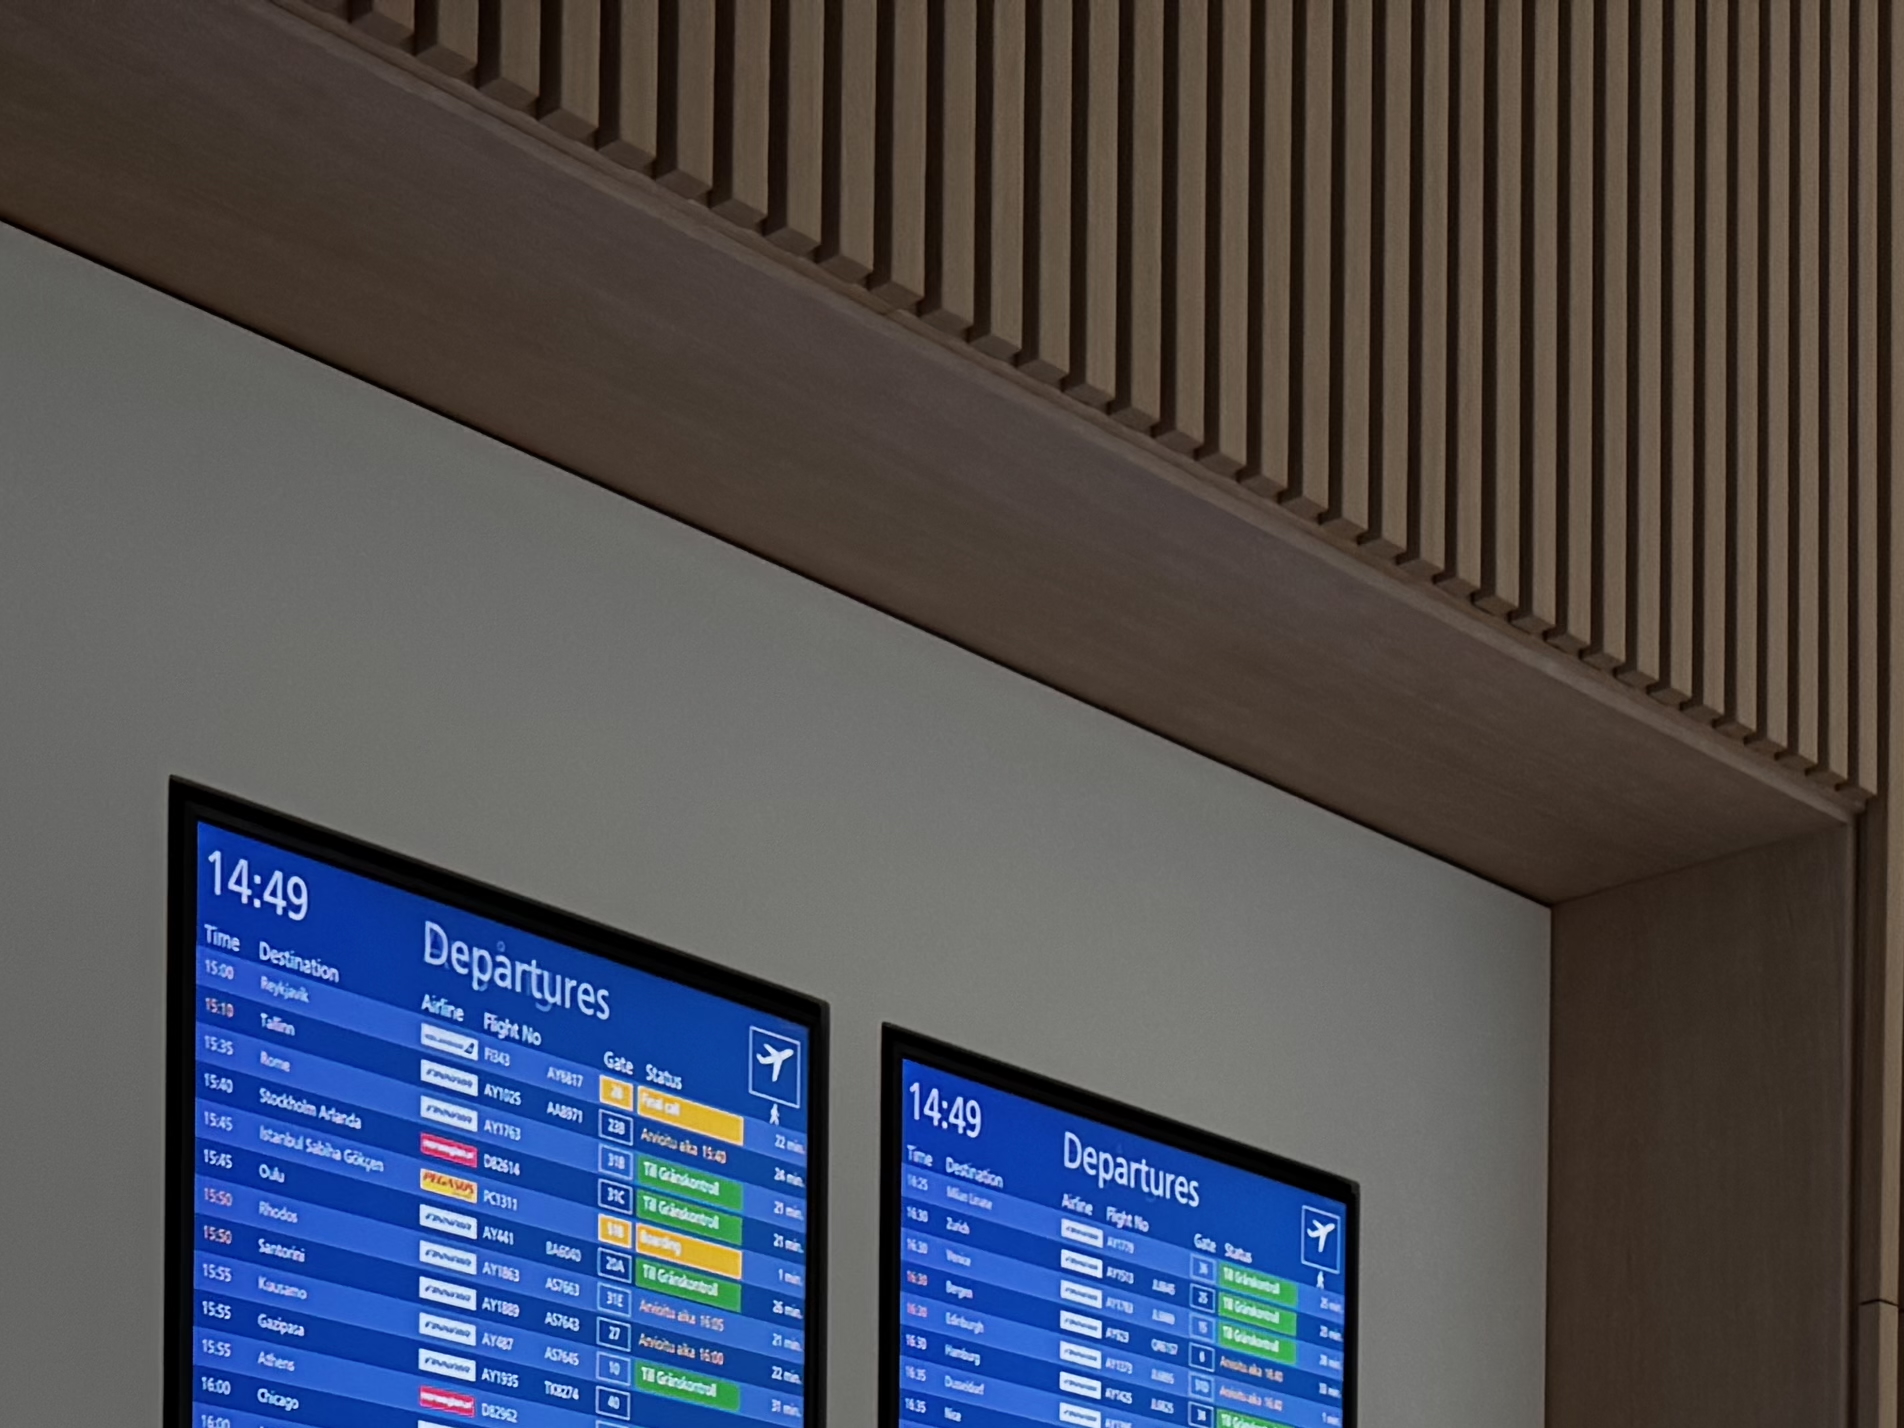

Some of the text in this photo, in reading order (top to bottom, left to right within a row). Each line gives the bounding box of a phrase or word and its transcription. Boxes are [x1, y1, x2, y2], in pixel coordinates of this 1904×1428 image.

[207, 849, 309, 921] 14:49
[423, 919, 610, 1021] Departures
[203, 922, 683, 1091] Time Destination Airline Flight No Gate Status
[259, 1011, 296, 1037] Tallinn
[259, 1049, 291, 1073] Rome
[258, 1086, 317, 1117] Stockholm
[317, 1104, 362, 1130] Arlanda
[908, 1081, 982, 1139] 14:49
[257, 1162, 286, 1184] Oulu
[1062, 1130, 1200, 1208] Departures
[258, 1200, 299, 1224] Rhodos
[257, 1237, 306, 1263] Santorini
[256, 1350, 295, 1372] Athens
[256, 1387, 300, 1412] Chicago
